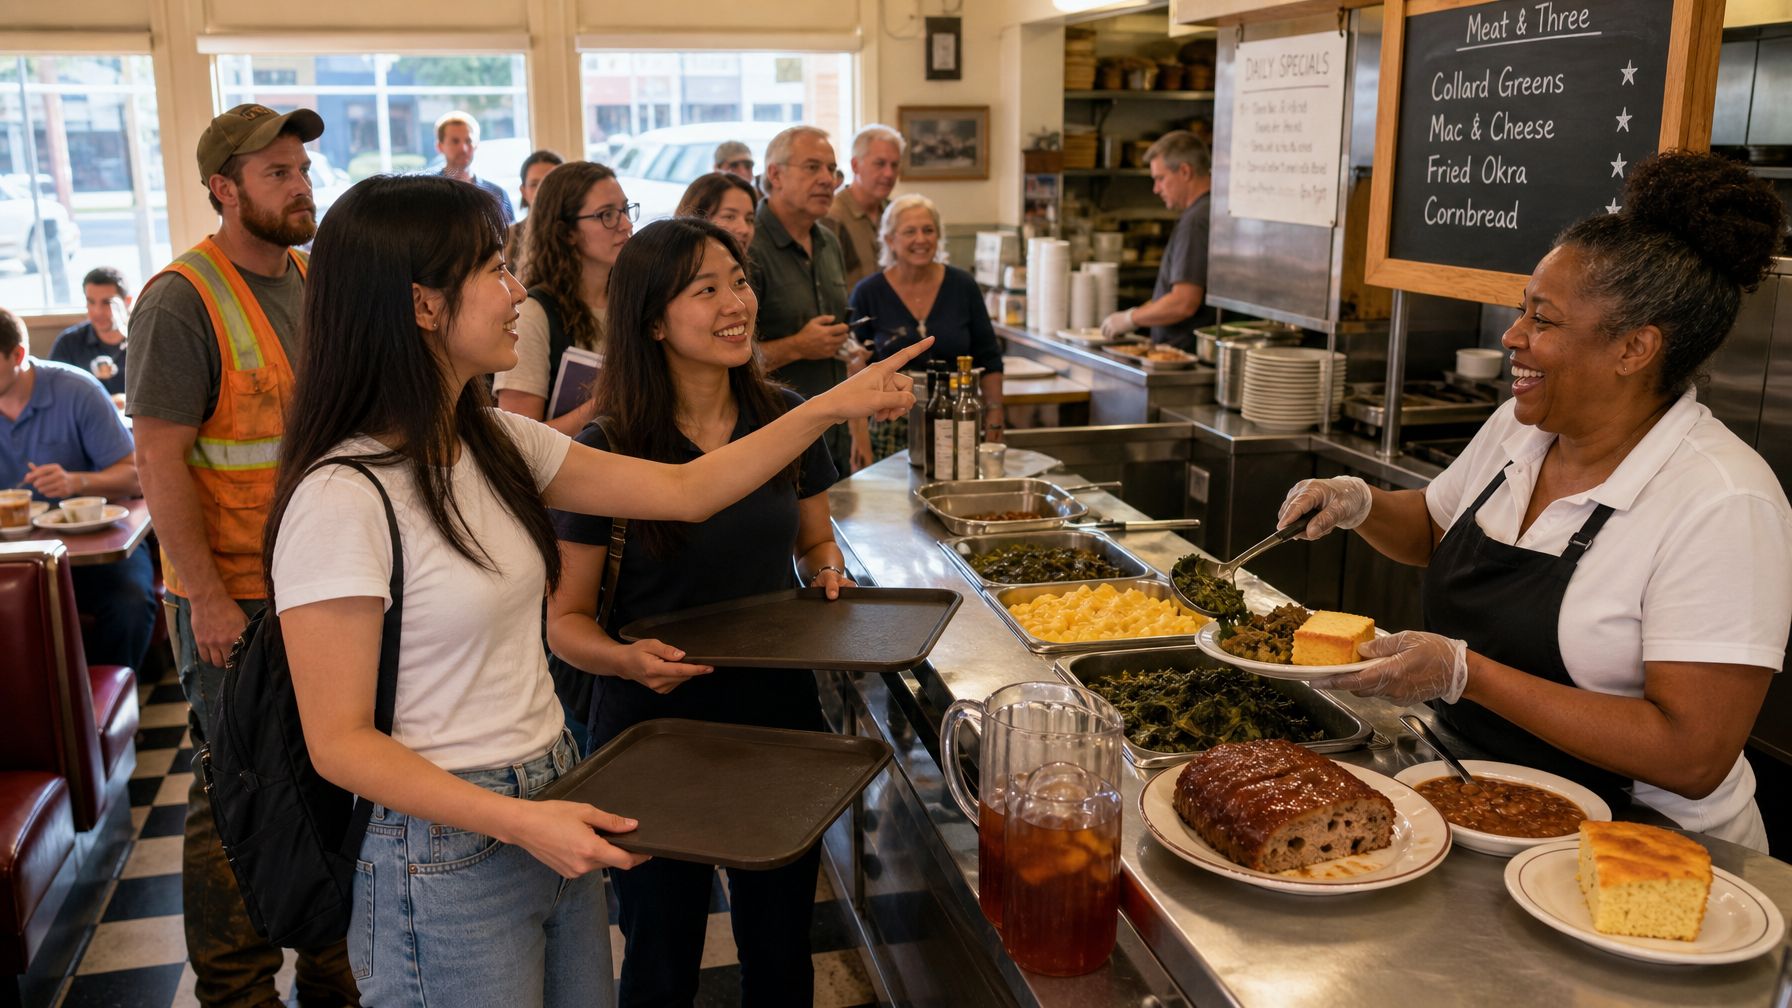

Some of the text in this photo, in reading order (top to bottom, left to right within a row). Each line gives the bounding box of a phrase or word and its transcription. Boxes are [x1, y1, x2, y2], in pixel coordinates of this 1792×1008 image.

[1466, 2, 1590, 43] Meat & Three
[1246, 51, 1330, 81] DAILY SPECIALS
[1431, 66, 1564, 101] Collard Greens
[1429, 111, 1555, 142] Mac & Cheese
[1427, 154, 1528, 184] Fried Okra
[1424, 195, 1519, 229] Cornbread
